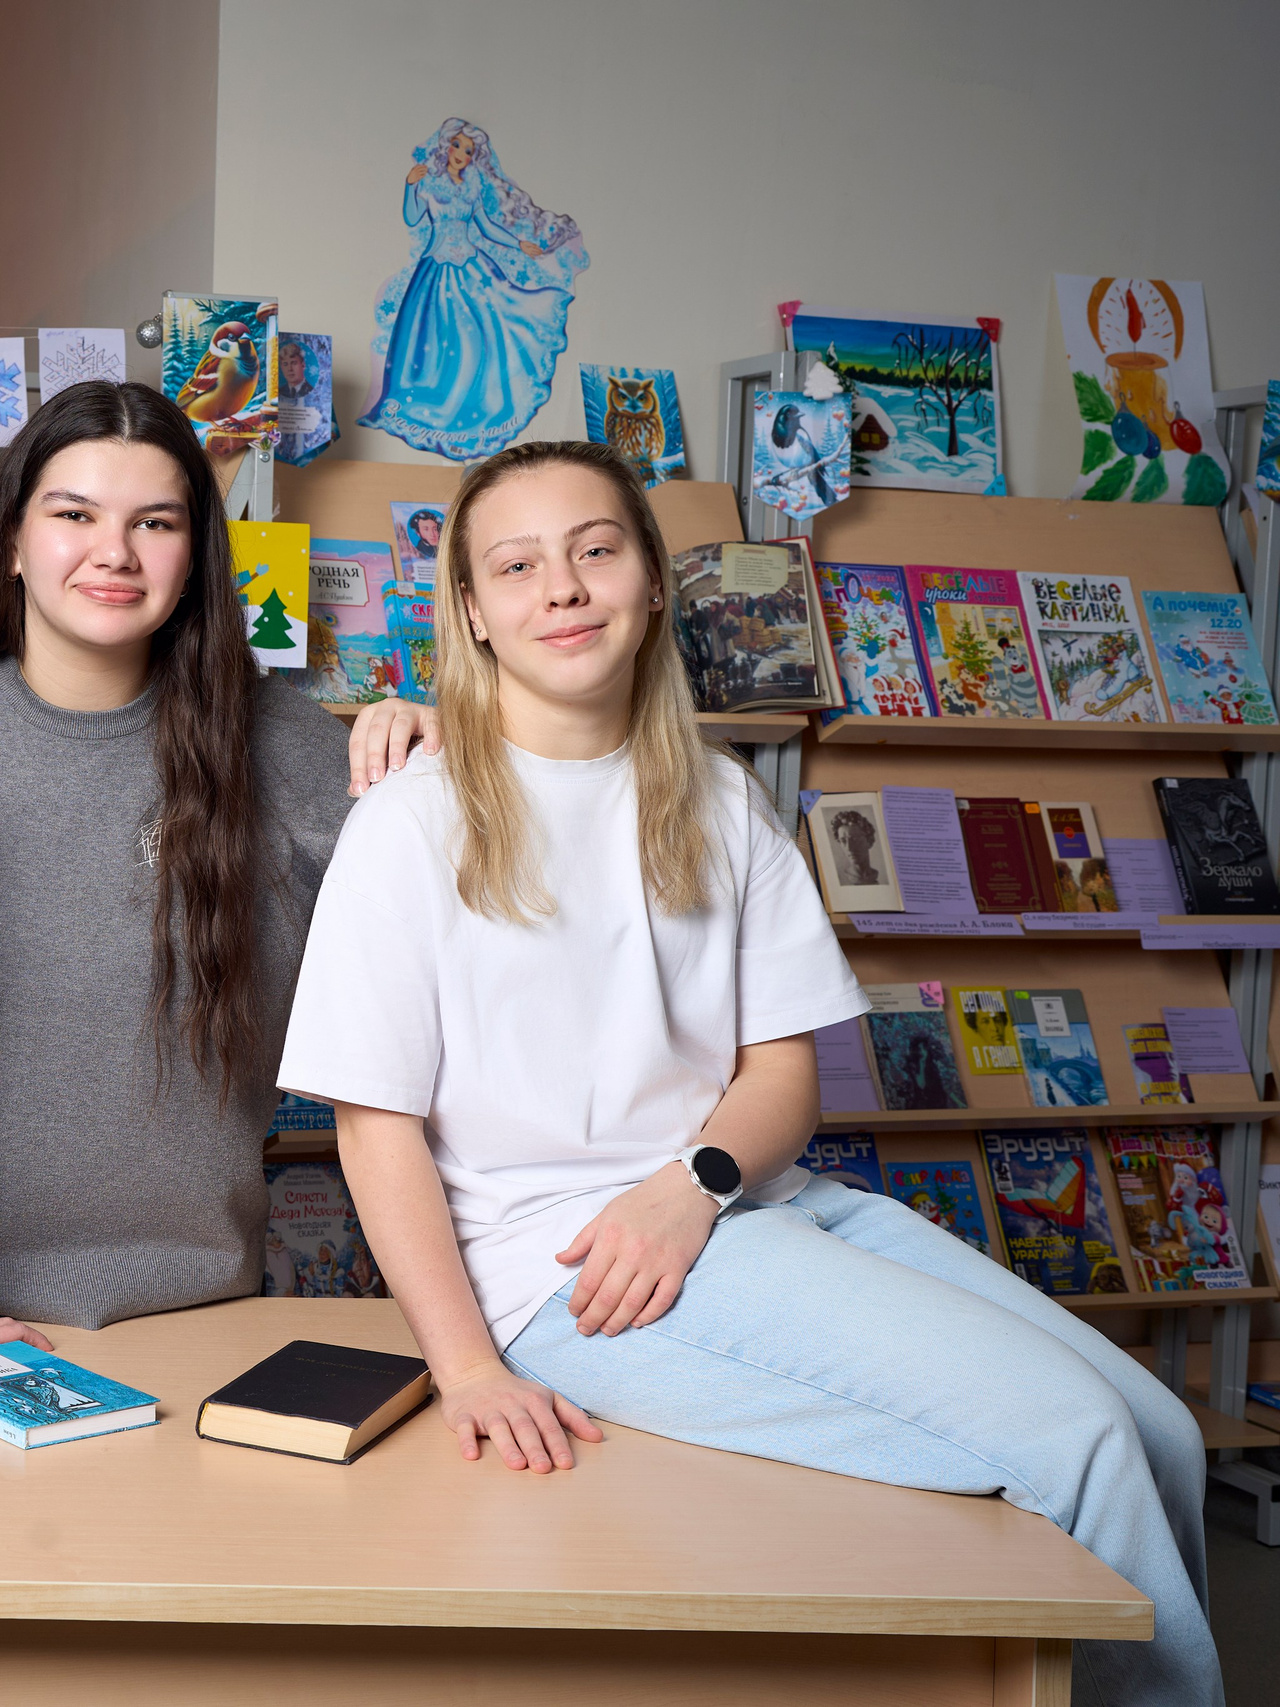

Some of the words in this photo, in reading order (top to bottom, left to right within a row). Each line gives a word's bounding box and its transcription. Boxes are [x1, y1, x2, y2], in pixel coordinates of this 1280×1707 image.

[380, 398, 519, 448] Зимушка-зима
[308, 565, 360, 578] ОДНАЯ
[317, 577, 351, 589] РЕЧЬ
[920, 570, 1008, 594] ВЕСЁЛЫЕ
[924, 586, 968, 605] уроки
[1036, 600, 1130, 624] КАРТИНКИ
[1153, 596, 1165, 611] А
[1168, 598, 1238, 618] почему?
[1210, 617, 1243, 629] 12.20
[1198, 856, 1263, 880] Зеркало
[1217, 876, 1254, 892] души
[856, 919, 873, 927] 145
[982, 921, 1014, 929] Блока
[271, 1113, 337, 1130] СНЕГУРОЧ
[801, 1141, 872, 1167] удит
[984, 1134, 1085, 1162] Эрудит
[284, 1190, 328, 1204] Спасти
[270, 1205, 300, 1221] Деда
[304, 1203, 345, 1218] Мороза!
[297, 1229, 326, 1238] СКАЗКА
[1008, 1236, 1076, 1249] НАВСТРЕЧУ
[1012, 1249, 1069, 1261] УРАГАНУ!
[1195, 1270, 1245, 1280] НОВОГОДНЯЯ
[1207, 1280, 1239, 1289] СКАЗКА
